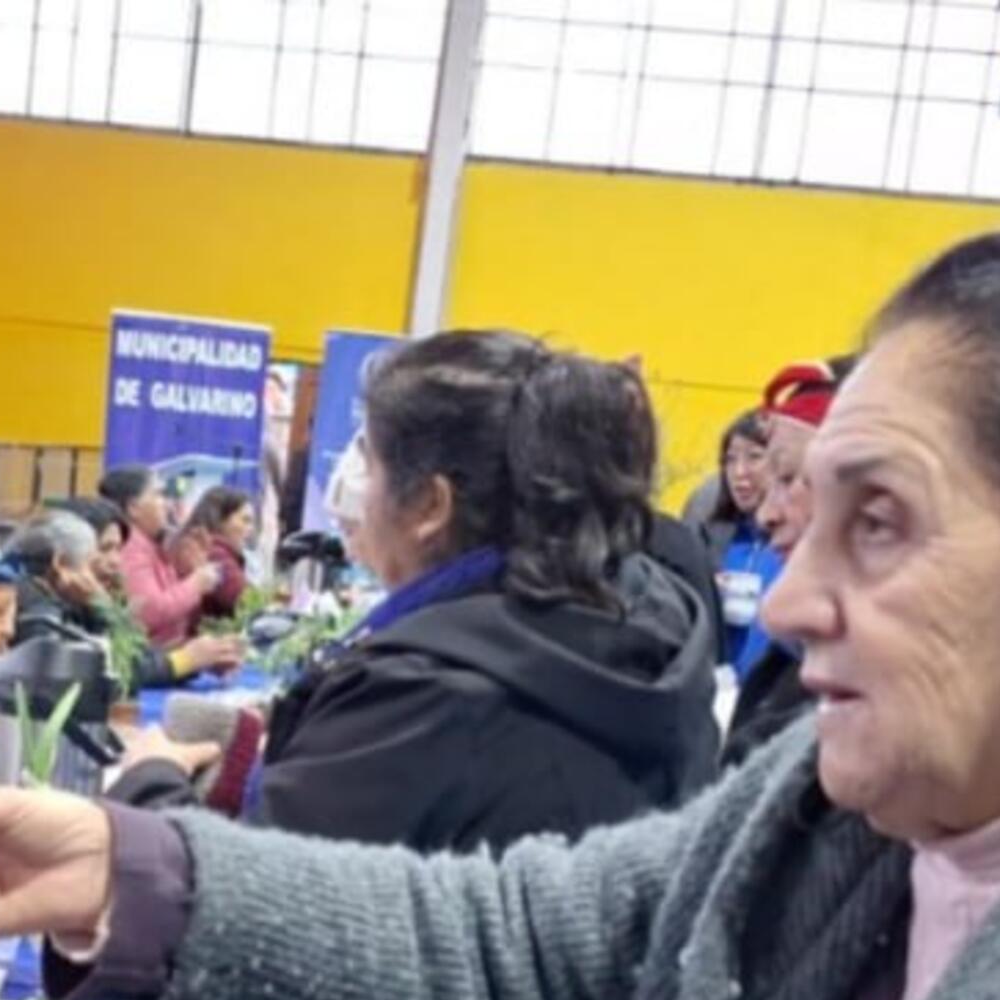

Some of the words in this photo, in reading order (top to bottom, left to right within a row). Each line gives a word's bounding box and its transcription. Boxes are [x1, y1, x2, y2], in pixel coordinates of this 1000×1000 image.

[116, 329, 263, 370] MUNICIPALIDAD
[114, 378, 141, 407] DE
[151, 382, 257, 418] GALVARINO
